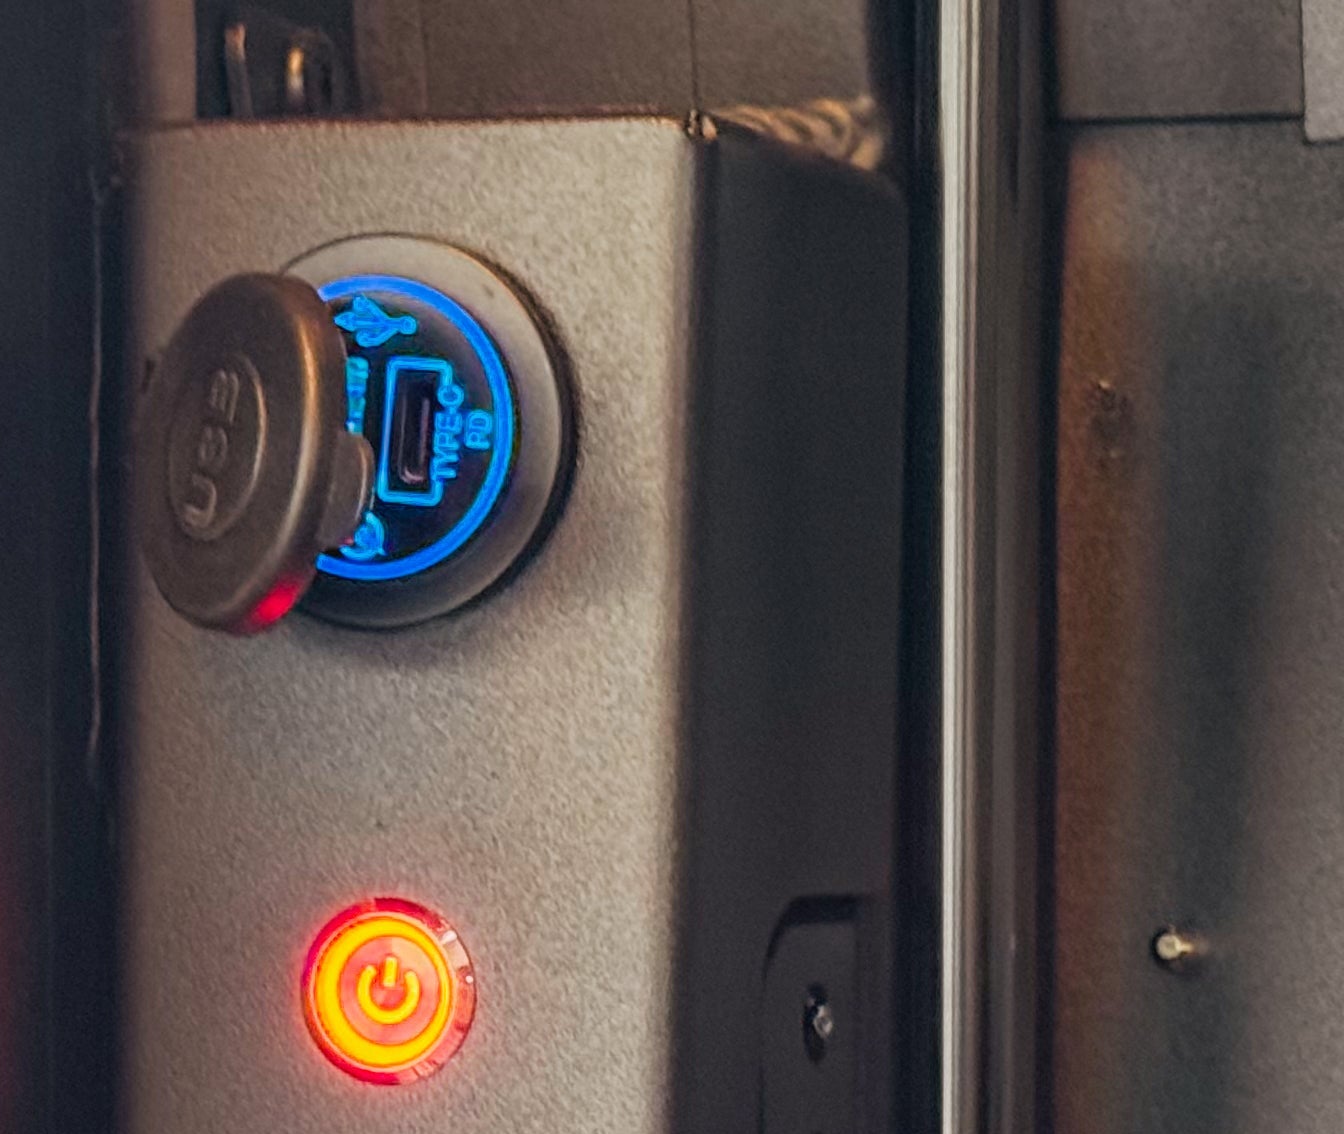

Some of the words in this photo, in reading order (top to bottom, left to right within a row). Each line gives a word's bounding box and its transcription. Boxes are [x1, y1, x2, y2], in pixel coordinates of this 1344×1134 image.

[183, 368, 240, 529] USB
[433, 384, 464, 480] TYPE-C
[464, 410, 493, 450] PD
